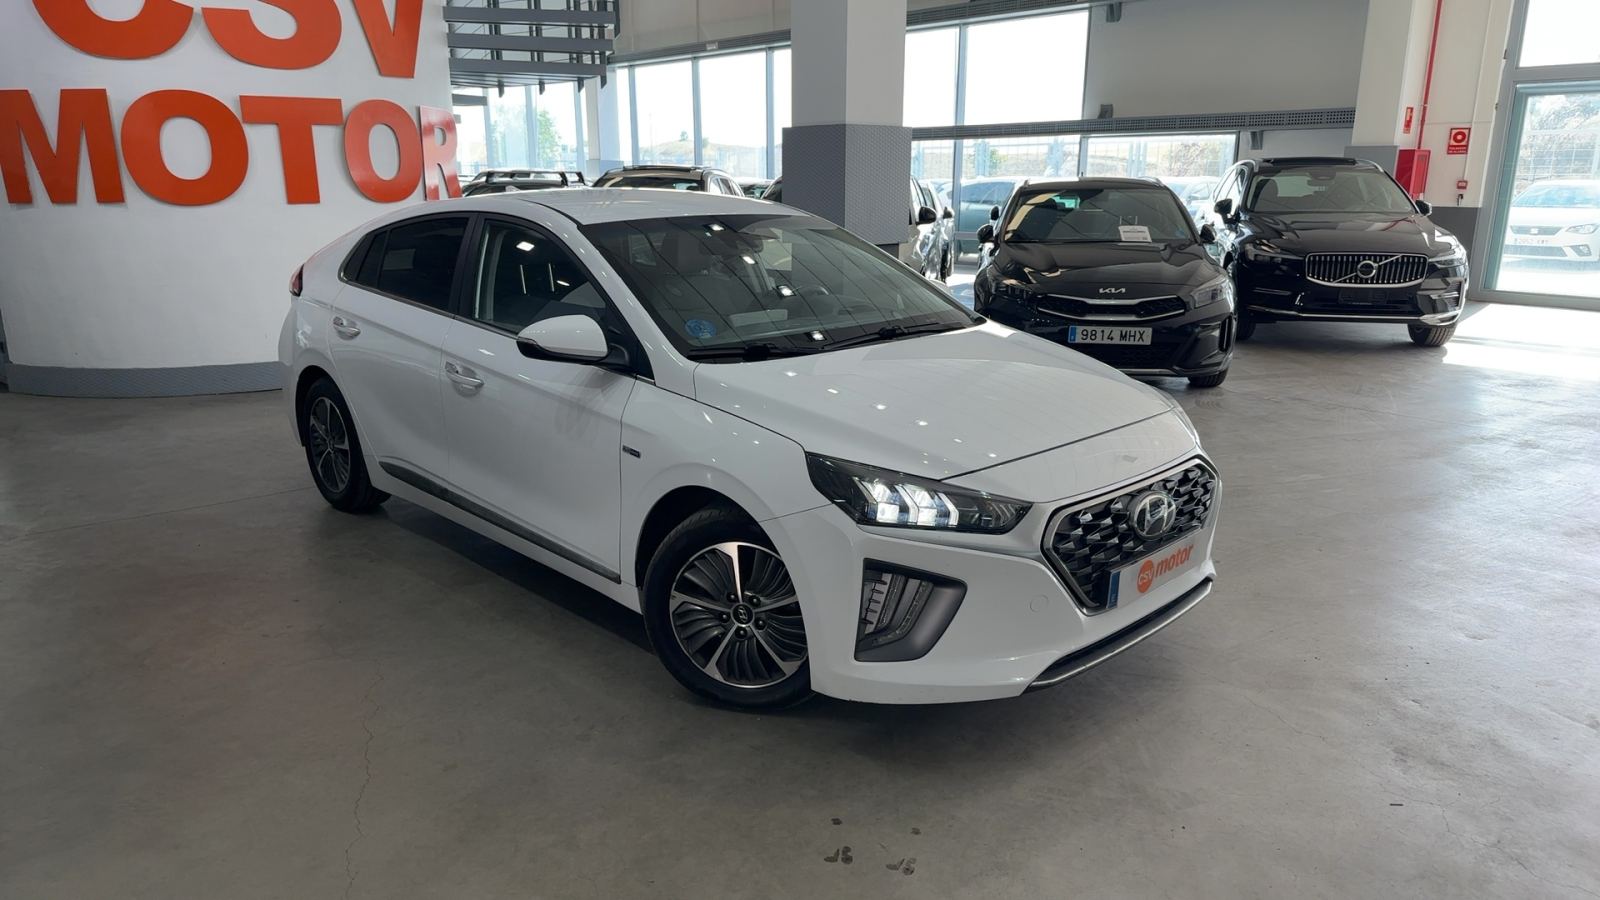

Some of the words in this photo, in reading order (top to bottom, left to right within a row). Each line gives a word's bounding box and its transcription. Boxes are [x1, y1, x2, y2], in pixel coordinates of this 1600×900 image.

[0, 88, 463, 206] MOTOR
[1080, 328, 1114, 341] 9814
[1119, 330, 1146, 342] MHX
[1155, 544, 1194, 578] motor
